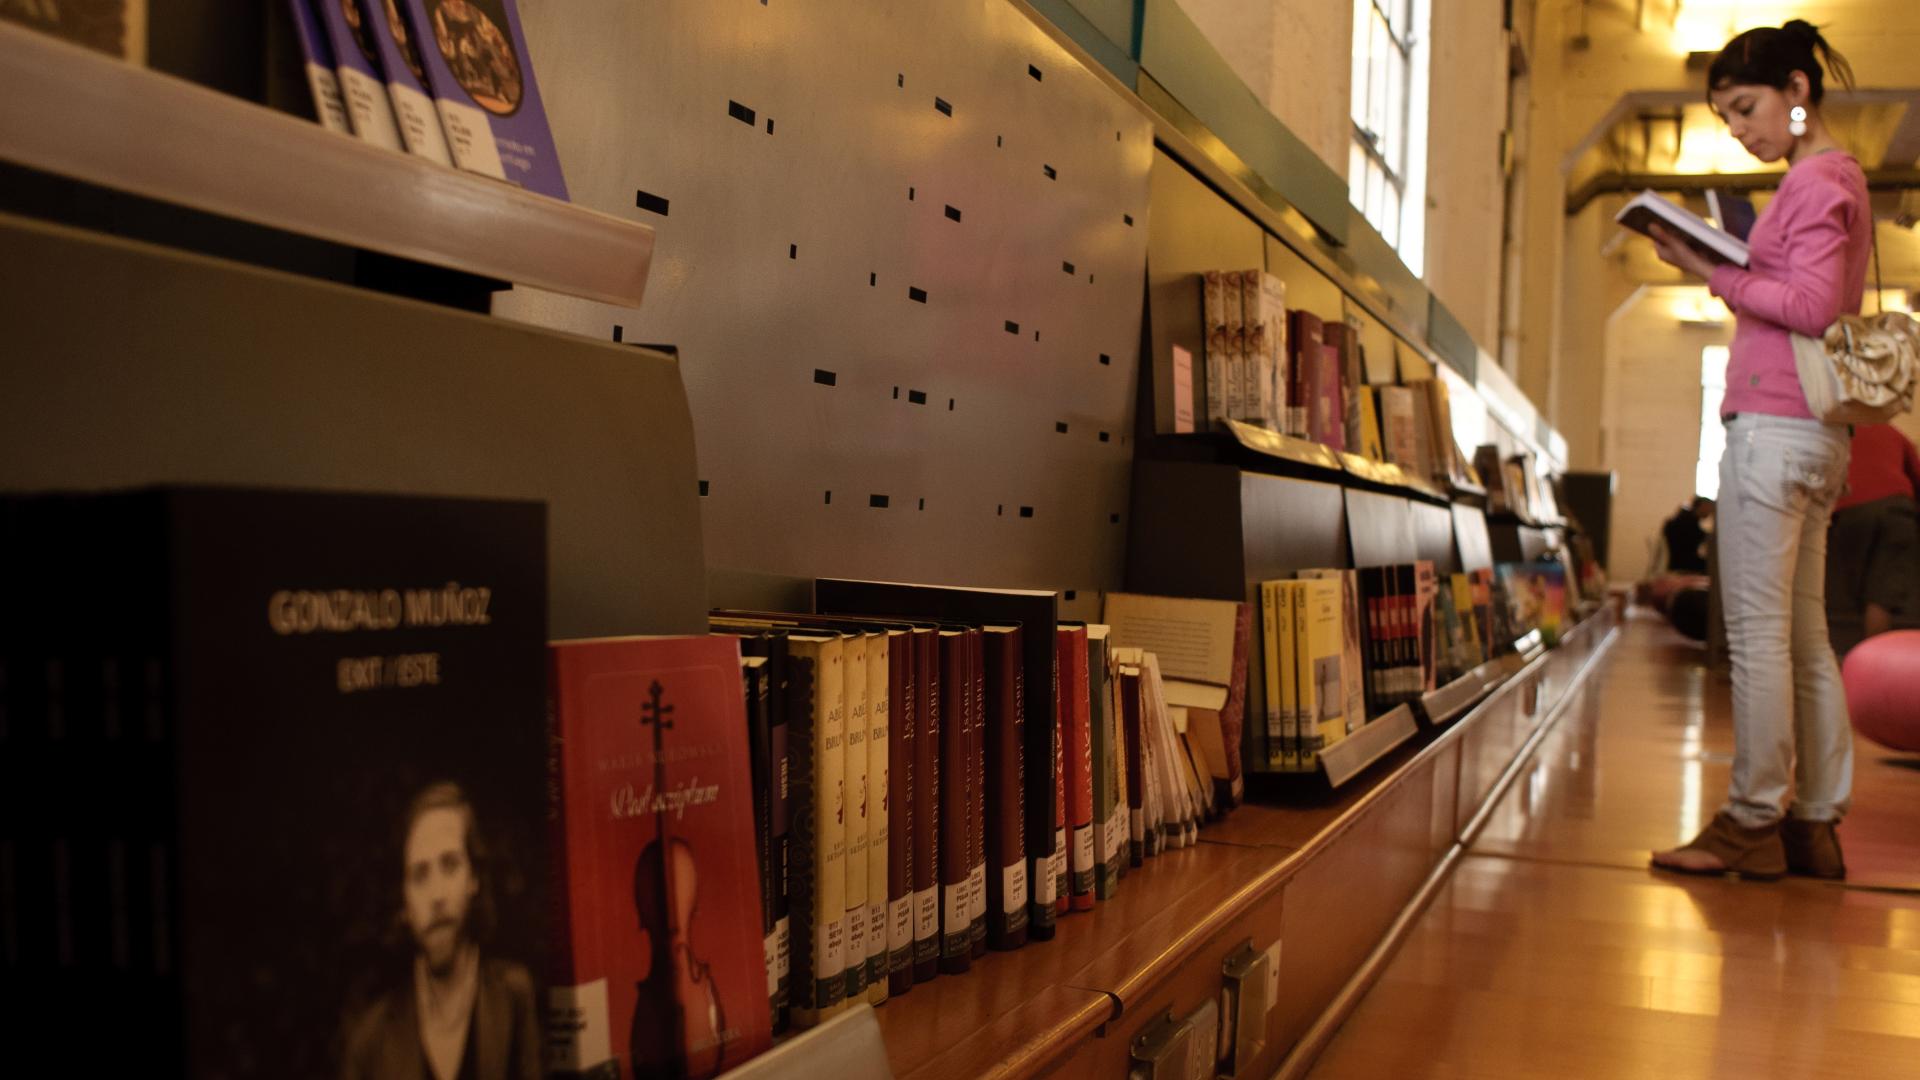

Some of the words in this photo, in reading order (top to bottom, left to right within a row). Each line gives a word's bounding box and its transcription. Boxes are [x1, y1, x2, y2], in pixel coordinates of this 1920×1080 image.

[267, 588, 402, 636] GONZALO
[403, 580, 492, 628] MUÑOZ
[903, 680, 912, 741] ISABEL
[927, 677, 937, 735] ISABEL
[962, 681, 970, 734] ISABEL
[975, 674, 984, 729] ISABEL
